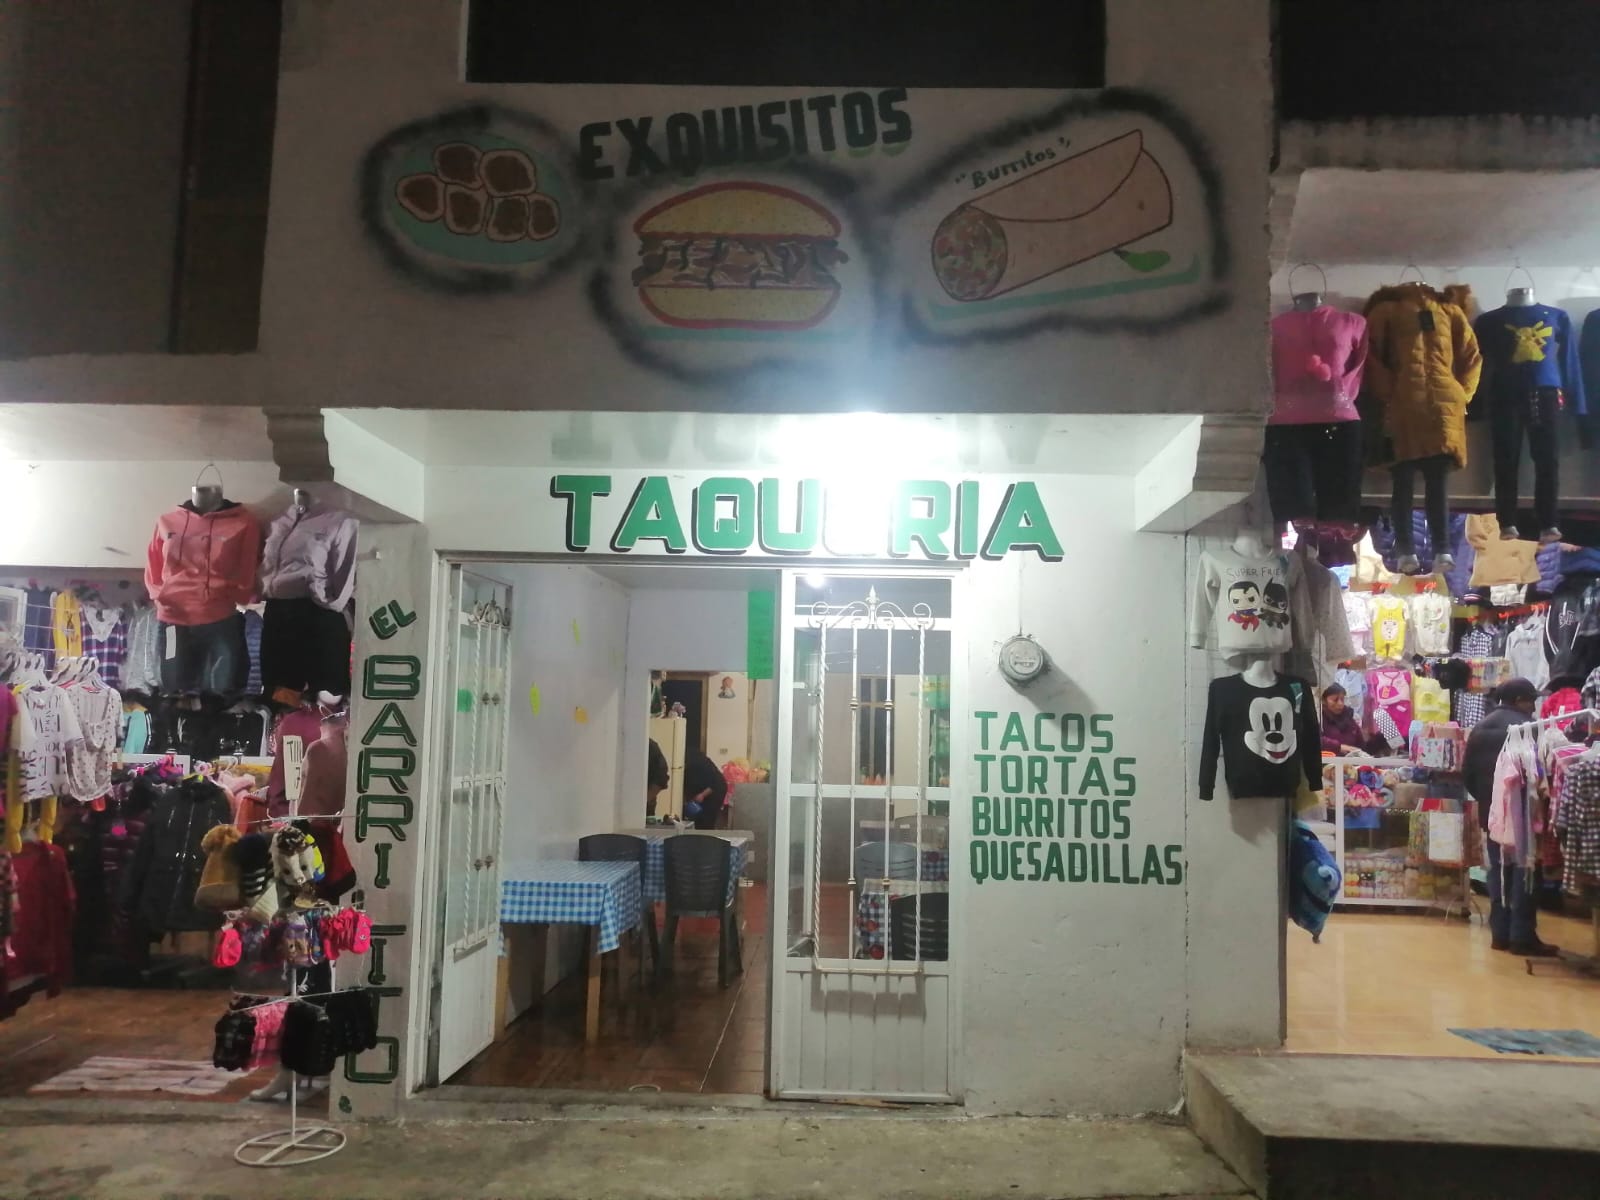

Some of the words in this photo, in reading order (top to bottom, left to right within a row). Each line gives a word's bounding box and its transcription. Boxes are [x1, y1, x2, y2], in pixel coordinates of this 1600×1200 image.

[580, 86, 912, 180] EXQUISITOS
[551, 475, 1065, 562] TAQURIA
[369, 600, 417, 640] EL
[974, 711, 1114, 754] TACOS
[974, 754, 1137, 797] TORTAS
[972, 796, 1131, 840] BURRITOS
[970, 840, 1183, 885] QUESADILLAS
